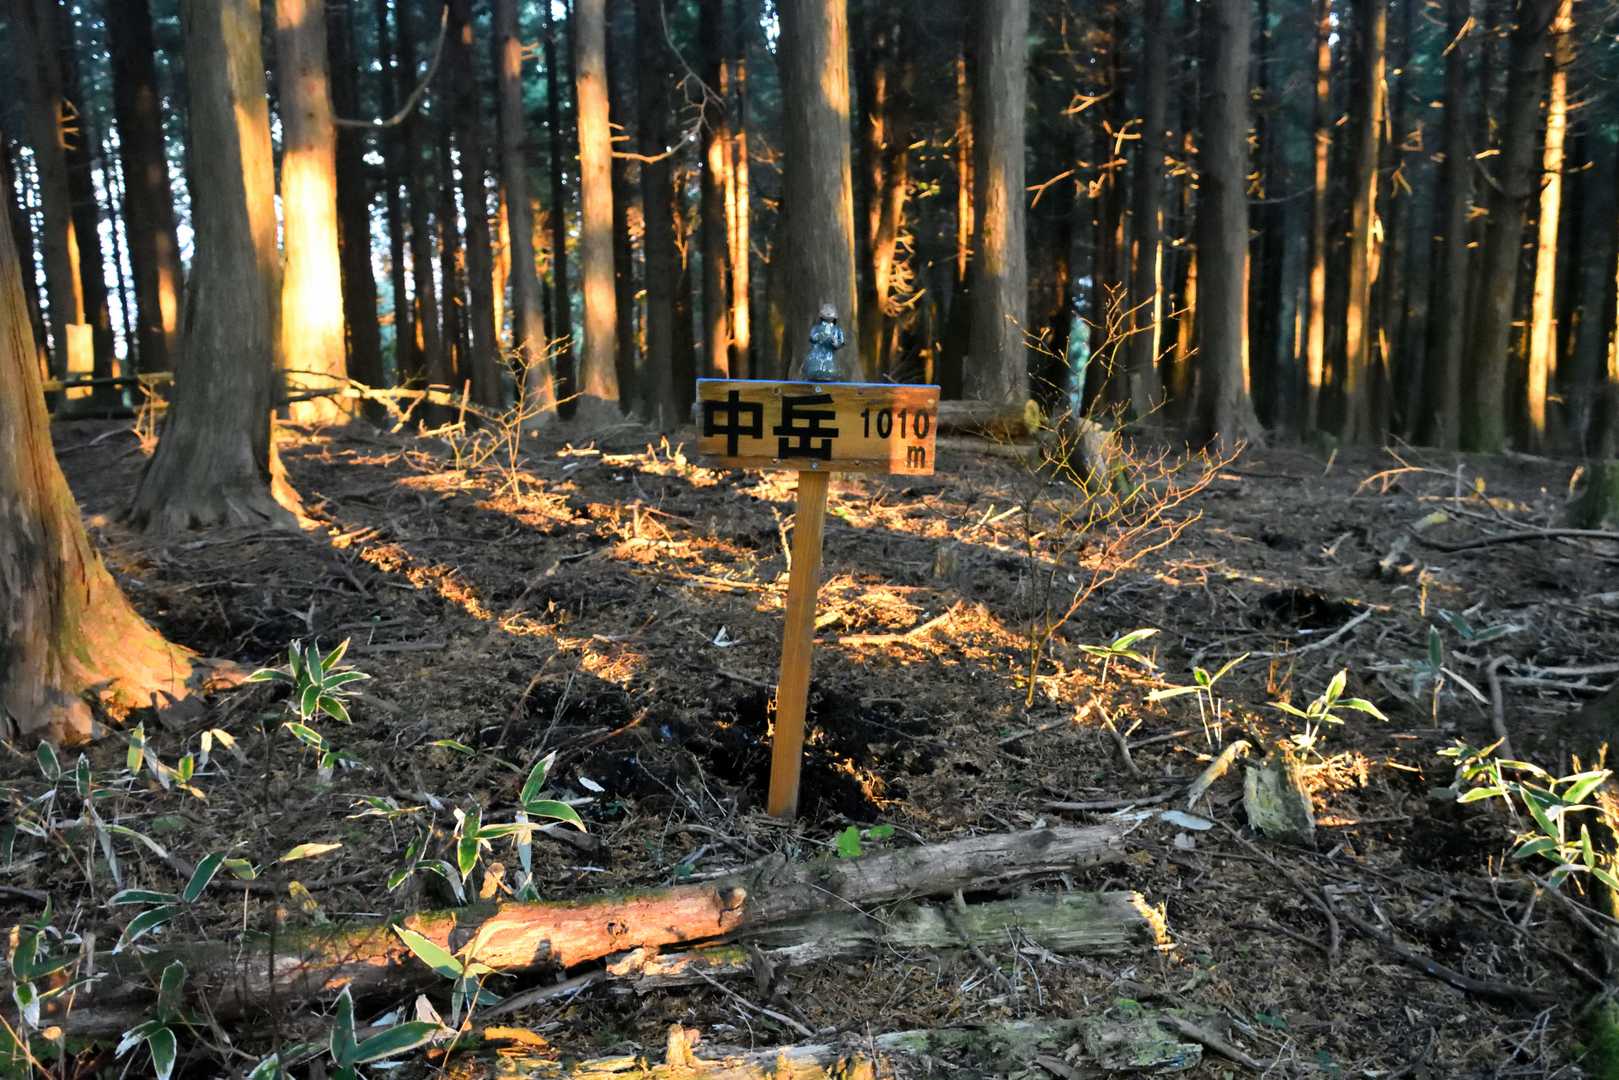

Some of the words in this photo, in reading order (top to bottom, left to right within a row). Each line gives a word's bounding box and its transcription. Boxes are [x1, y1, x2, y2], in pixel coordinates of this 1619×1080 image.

[703, 390, 839, 460] 中岳
[859, 407, 930, 440] 1010
[906, 444, 926, 469] m
